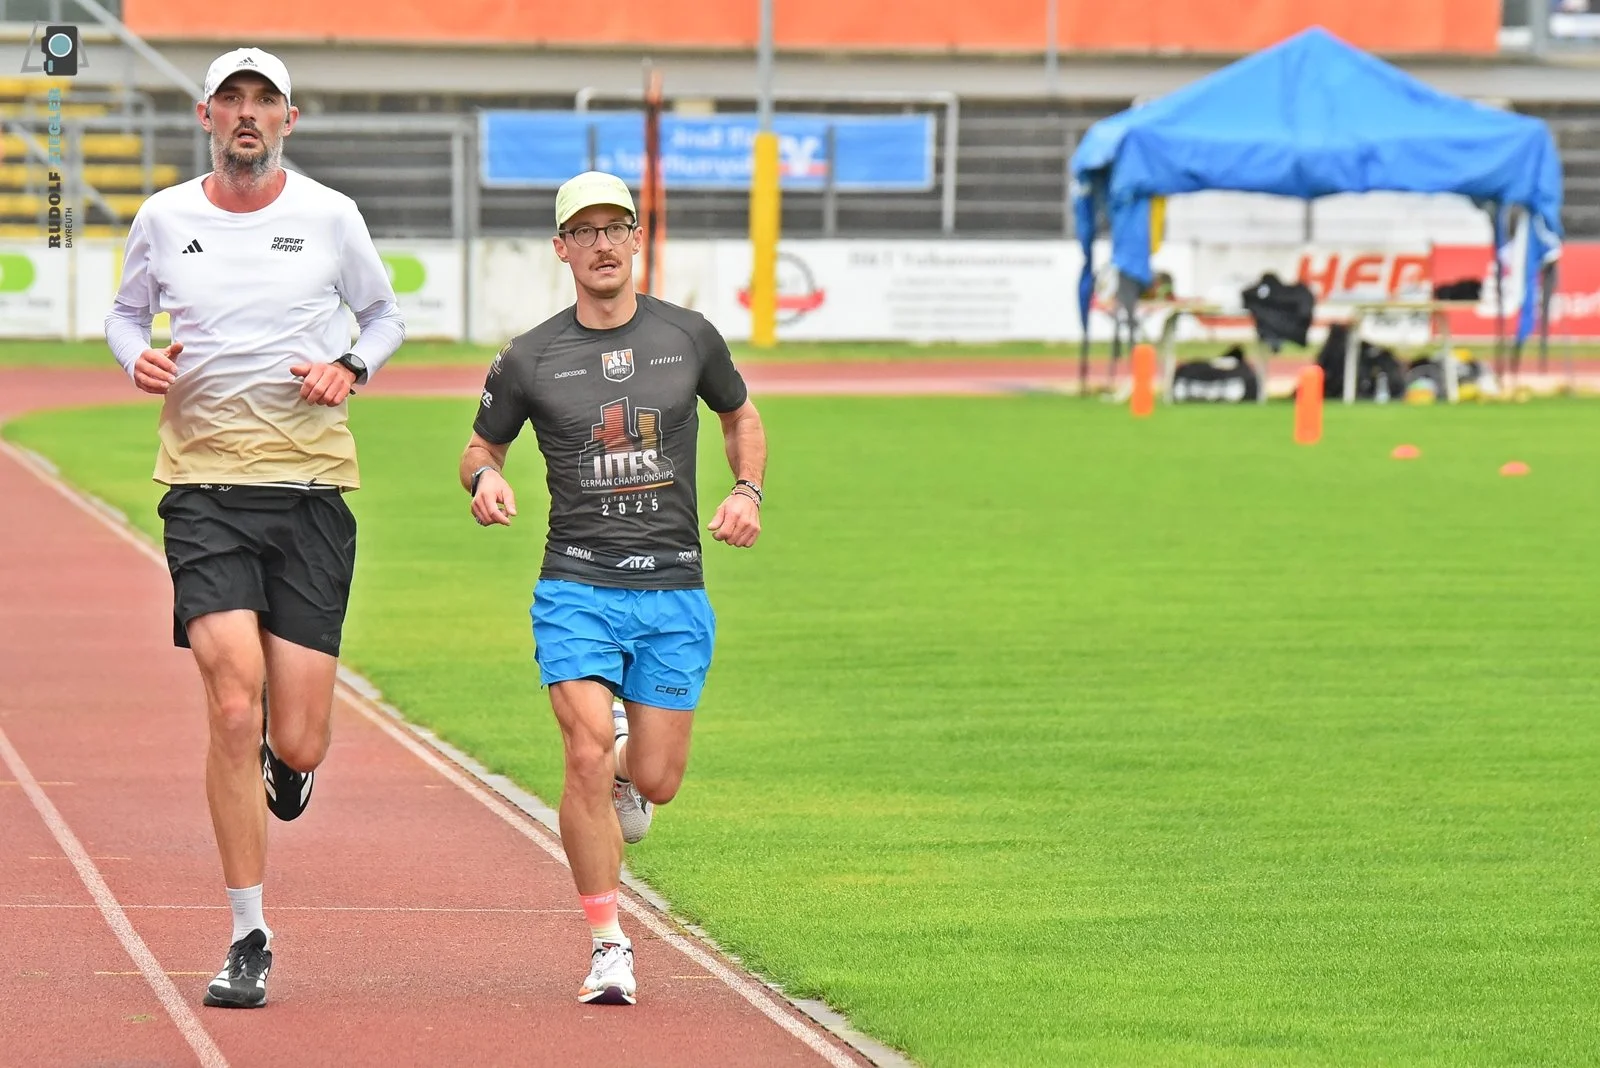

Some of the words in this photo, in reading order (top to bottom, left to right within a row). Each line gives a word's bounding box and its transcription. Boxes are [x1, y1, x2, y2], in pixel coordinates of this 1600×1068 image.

[580, 478, 612, 488] GERMAN
[613, 469, 674, 486] CHAMPIONSHIPS
[601, 491, 658, 503] ULTRATRAIL
[655, 684, 688, 696] cep
